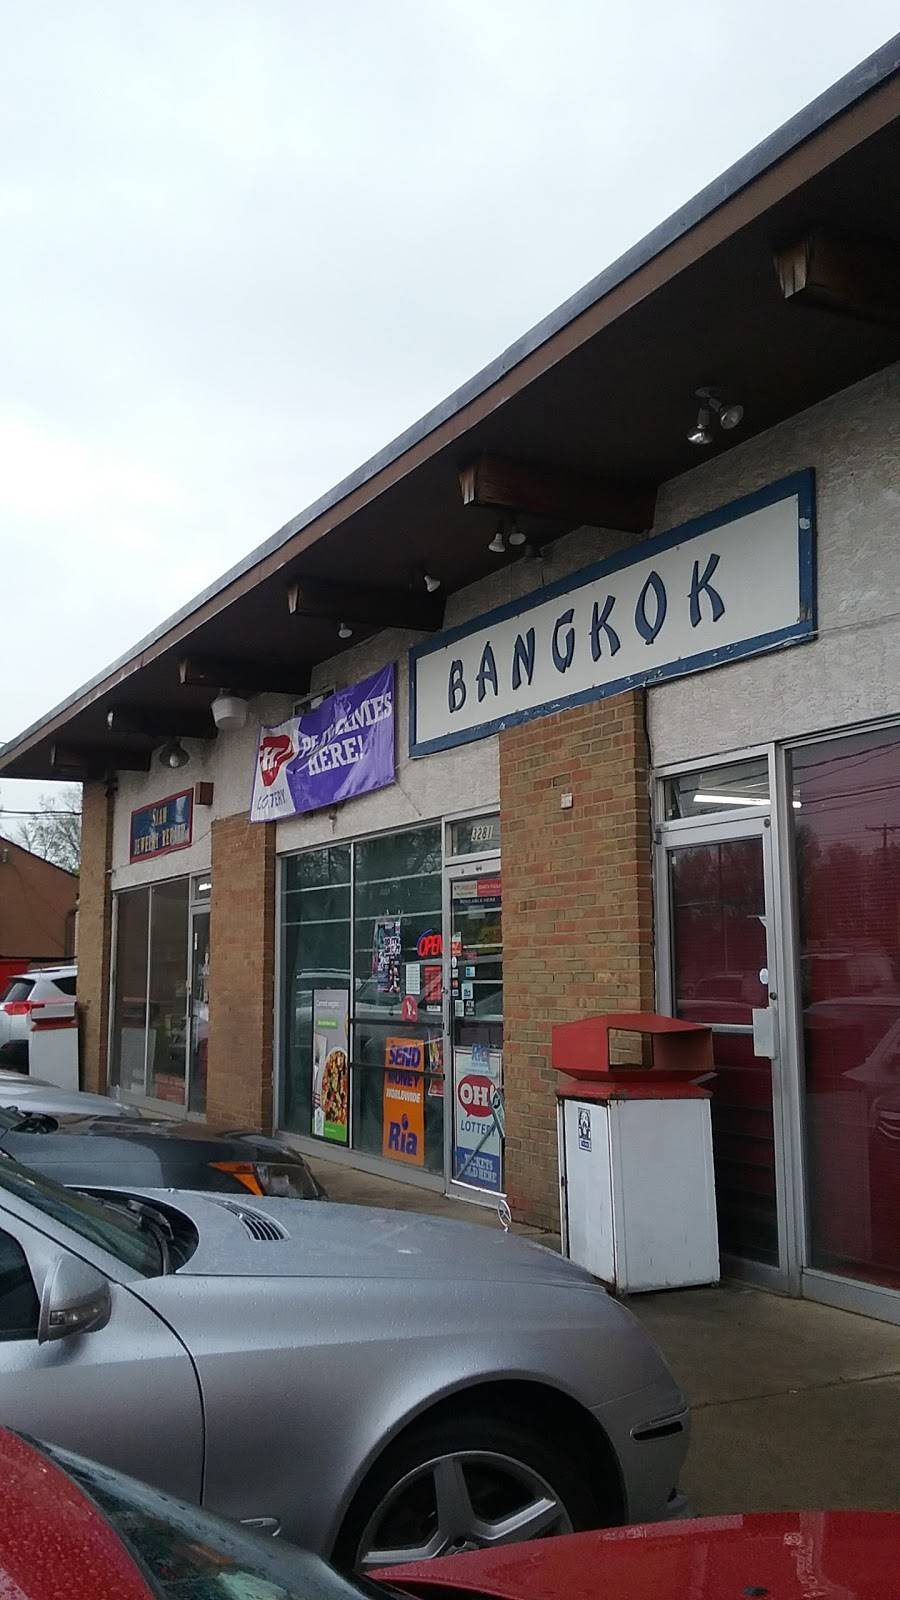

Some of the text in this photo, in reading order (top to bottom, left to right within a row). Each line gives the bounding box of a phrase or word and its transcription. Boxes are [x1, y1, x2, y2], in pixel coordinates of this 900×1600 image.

[448, 553, 725, 713] BANGKOK
[308, 735, 364, 776] HERE!
[389, 1046, 421, 1068] SEND
[388, 1071, 420, 1088] MONEY
[388, 1113, 417, 1156] Ria
[461, 1119, 496, 1137] LOTTERY
